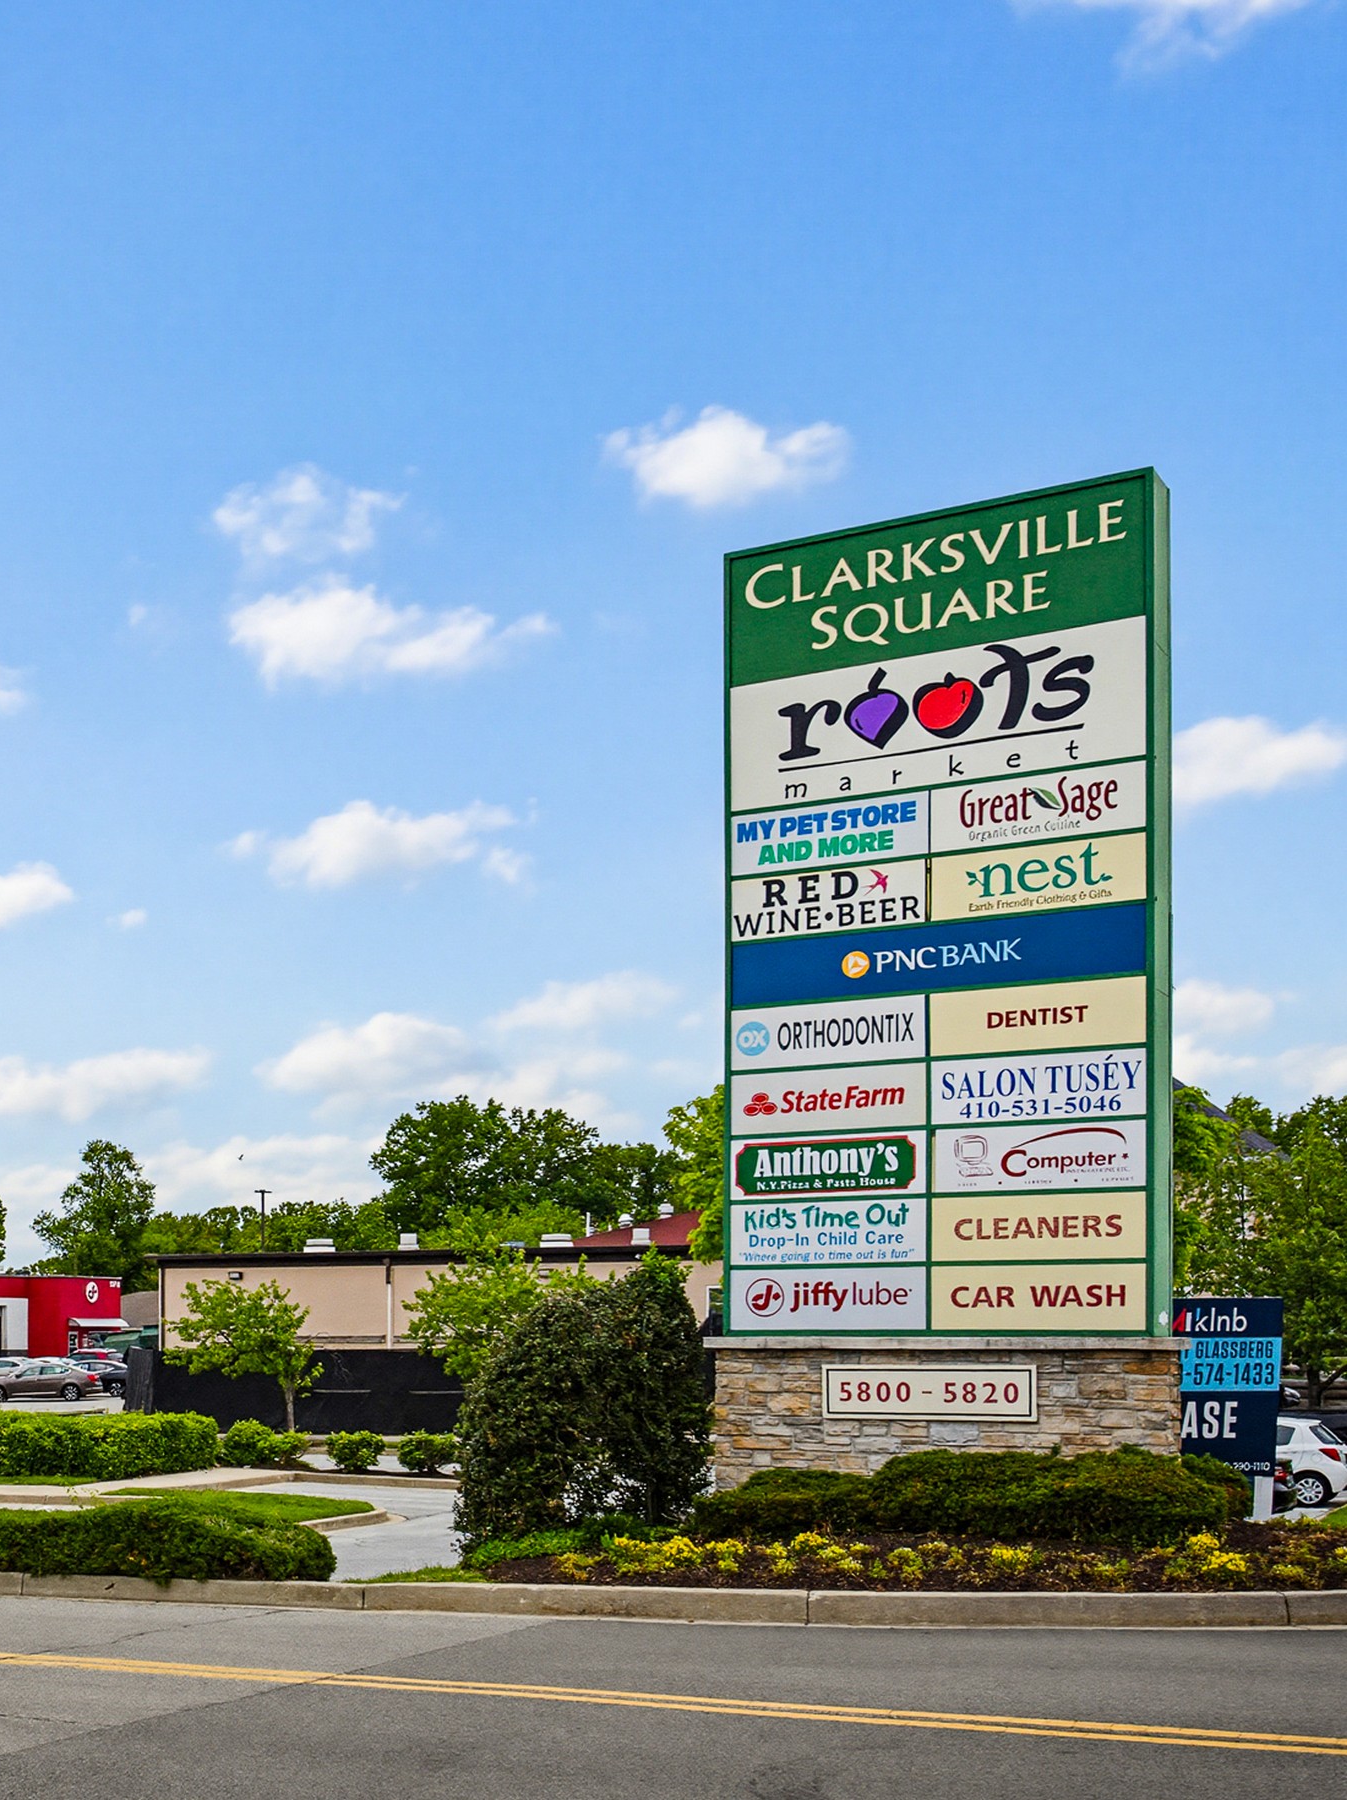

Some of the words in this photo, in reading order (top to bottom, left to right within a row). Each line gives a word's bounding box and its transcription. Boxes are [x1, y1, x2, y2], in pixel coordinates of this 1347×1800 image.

[744, 499, 1128, 610] CLARKSVILLE
[810, 569, 1052, 651] SQUARE
[777, 643, 1095, 762] roots
[783, 739, 1080, 799] market
[959, 787, 1033, 828] Great
[1054, 775, 1119, 822] Sage
[737, 819, 775, 843] MY
[779, 812, 829, 838] PET
[831, 800, 917, 832] STORE
[757, 840, 813, 866] AND
[818, 829, 894, 858] MORE
[978, 842, 1100, 898] nest
[762, 870, 859, 908] RED
[873, 946, 937, 973] PNC
[938, 938, 1022, 967] BANK
[777, 1012, 914, 1051] ORTHODONTIX
[987, 1005, 1089, 1029] DENTIST
[942, 1066, 1037, 1100] SALON
[1044, 1053, 1142, 1094] TUSÉY
[960, 1094, 1122, 1118] 410-531-5046
[754, 1142, 899, 1178] Anthony's
[1001, 1149, 1116, 1177] Computer
[859, 1177, 896, 1186] House
[745, 1207, 797, 1232] Kid's
[802, 1205, 860, 1229] Time
[866, 1203, 909, 1227] Out
[954, 1214, 1123, 1240] CLEANERS
[749, 1233, 810, 1249] Drop-In
[817, 1231, 858, 1245] Child
[865, 1230, 904, 1245] Care
[780, 1251, 810, 1263] going
[814, 1251, 825, 1260] to
[828, 1249, 853, 1260] time
[856, 1249, 874, 1260] out
[877, 1248, 886, 1259] is
[950, 1286, 1015, 1308] CAR
[1030, 1284, 1126, 1307] WASH
[1195, 1307, 1248, 1332] klnb
[1195, 1341, 1273, 1359] GLASSBERG
[1180, 1362, 1275, 1386] -574-1433
[839, 1381, 911, 1403] 5800
[943, 1382, 1019, 1404] 5820
